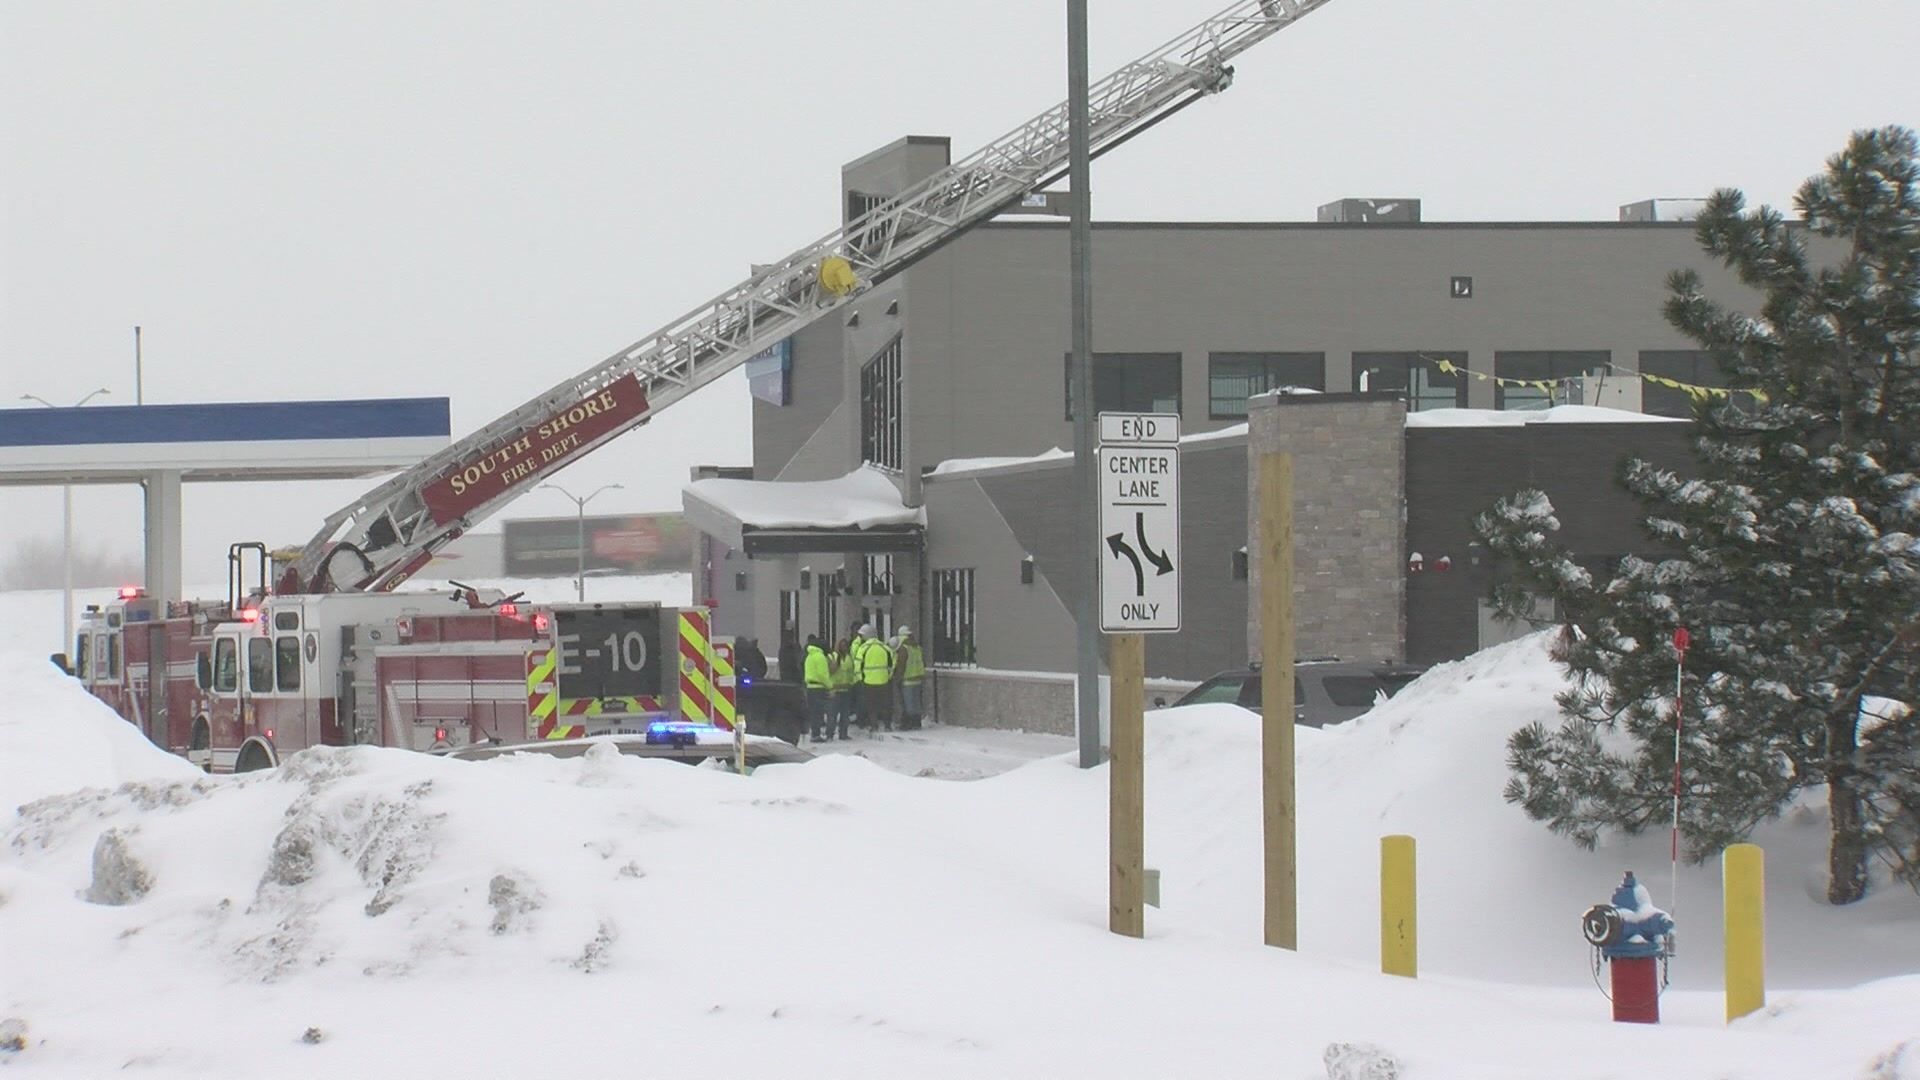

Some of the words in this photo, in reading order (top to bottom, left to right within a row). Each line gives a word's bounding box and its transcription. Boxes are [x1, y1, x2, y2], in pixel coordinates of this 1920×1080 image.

[1122, 420, 1156, 437] END
[450, 437, 532, 495] SOUTH
[538, 390, 617, 440] SHORE
[501, 457, 538, 485] FIRE
[540, 432, 582, 463] DEPT.
[1109, 456, 1169, 474] CENTER
[1119, 480, 1160, 498] LANE
[1121, 603, 1160, 620] ONLY
[558, 631, 647, 674] E-10
